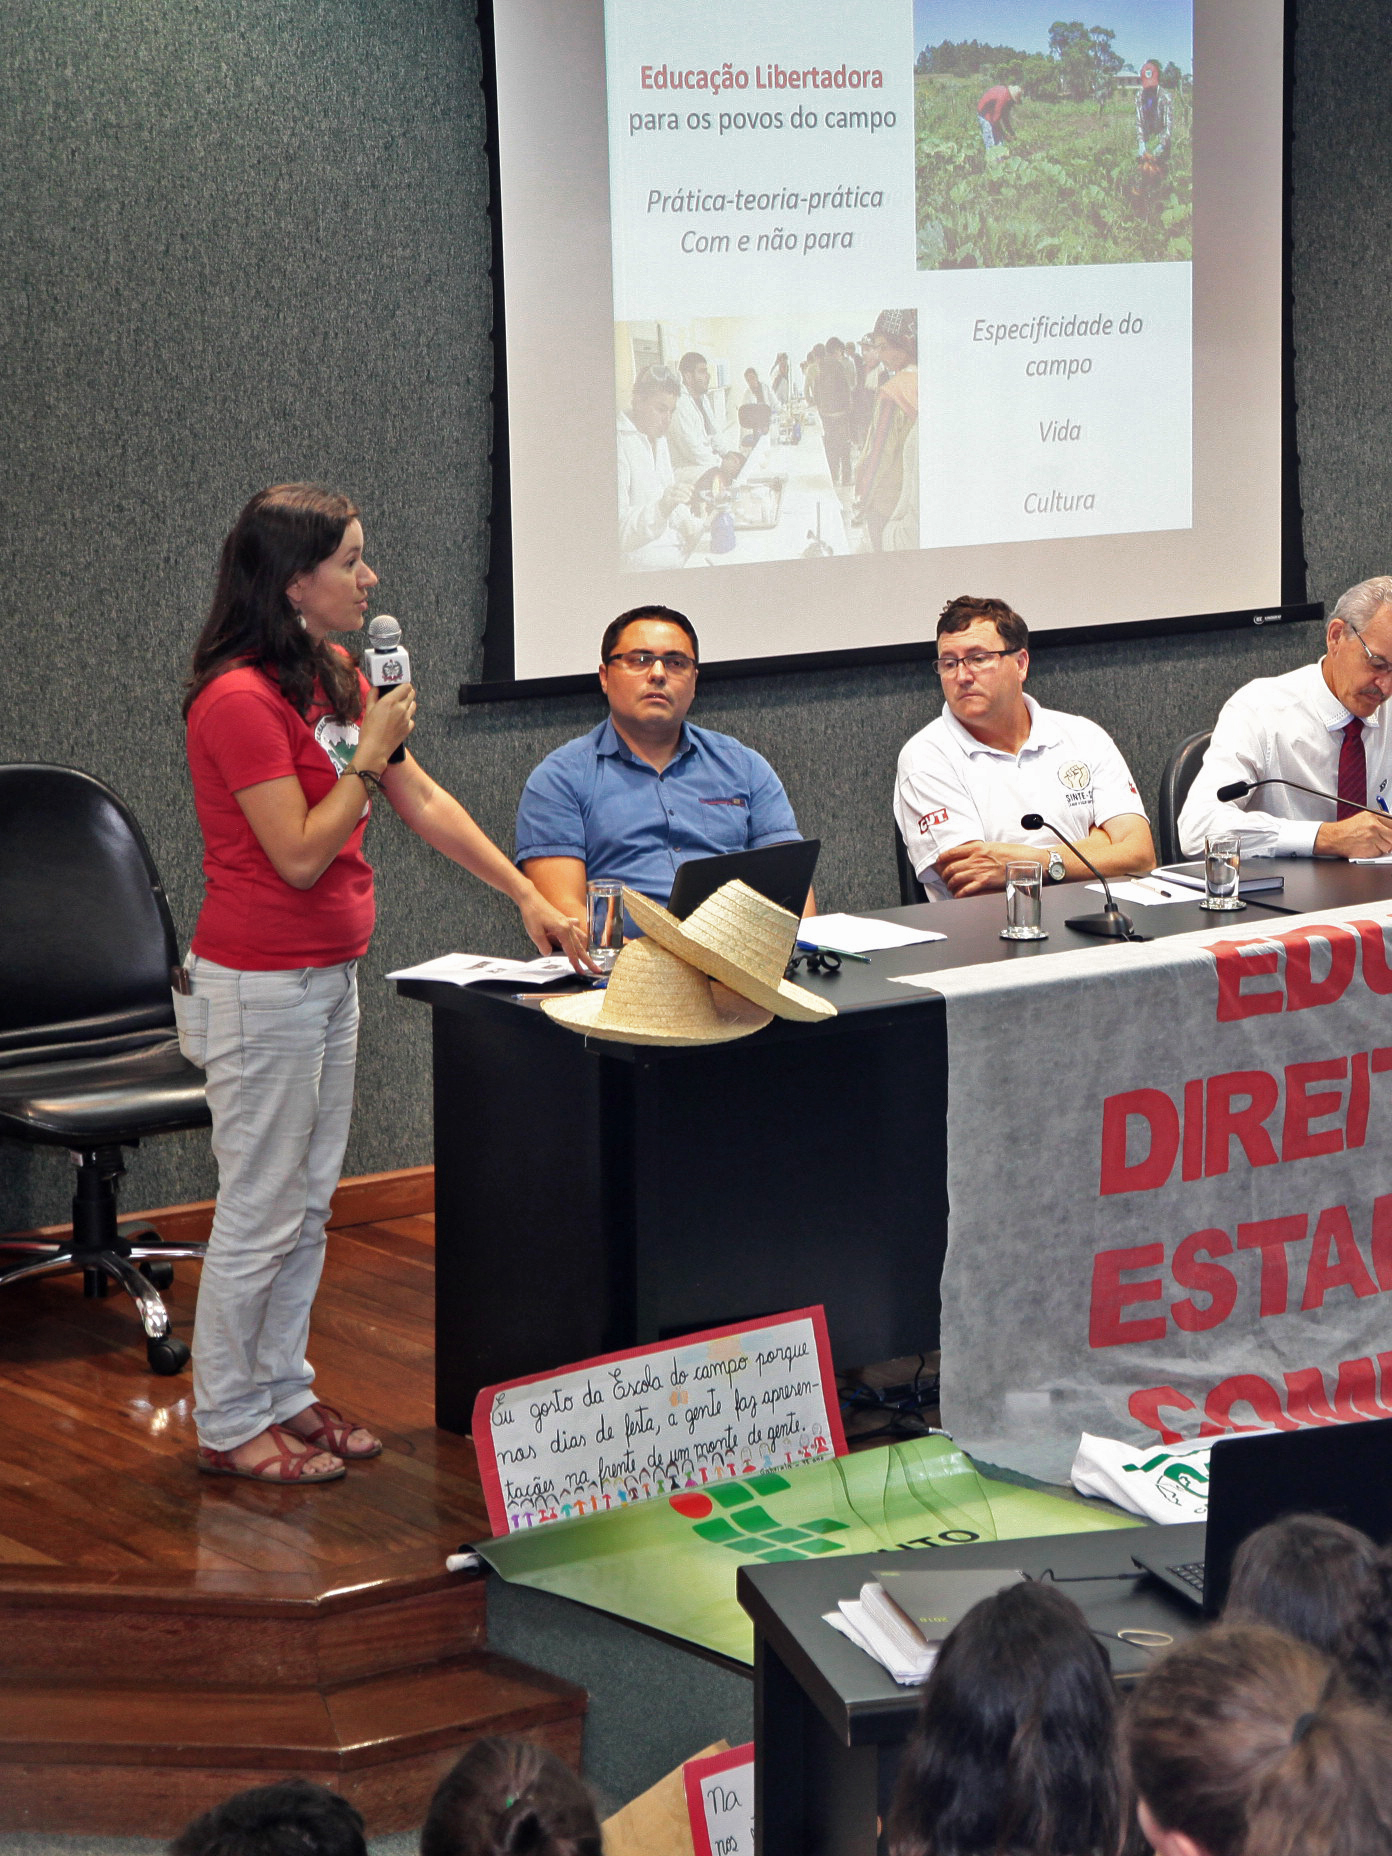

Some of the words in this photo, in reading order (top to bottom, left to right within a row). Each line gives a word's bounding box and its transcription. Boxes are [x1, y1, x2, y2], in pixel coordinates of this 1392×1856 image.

[640, 62, 749, 95] Educação
[756, 63, 883, 90] Libertadora
[629, 109, 678, 136] para
[686, 109, 711, 131] os
[718, 107, 784, 132] povos
[790, 104, 818, 129] do
[824, 108, 896, 132] campo
[647, 186, 883, 214] Prática-teoria-prática
[681, 230, 730, 253] Com
[738, 234, 750, 252] e
[757, 228, 797, 252] não
[803, 231, 853, 256] para
[973, 314, 1113, 344] Especificidade
[1119, 312, 1143, 335] do
[1025, 356, 1092, 382] campo
[1039, 420, 1081, 443] Vida
[1024, 491, 1095, 515] Cultura
[530, 1389, 574, 1433] gosto
[583, 1379, 604, 1407] da
[608, 1364, 663, 1400] Escola
[670, 1356, 689, 1386] do
[693, 1356, 748, 1389] campo
[756, 1342, 810, 1377] porque
[497, 1445, 537, 1465] nos
[550, 1429, 587, 1453] dias
[596, 1414, 615, 1443] de
[624, 1405, 660, 1447] festa,
[668, 1413, 678, 1426] a
[685, 1388, 722, 1435] gente
[734, 1388, 757, 1422] faz
[598, 1449, 636, 1493] frente
[647, 1445, 664, 1468] de
[748, 1424, 763, 1446] de
